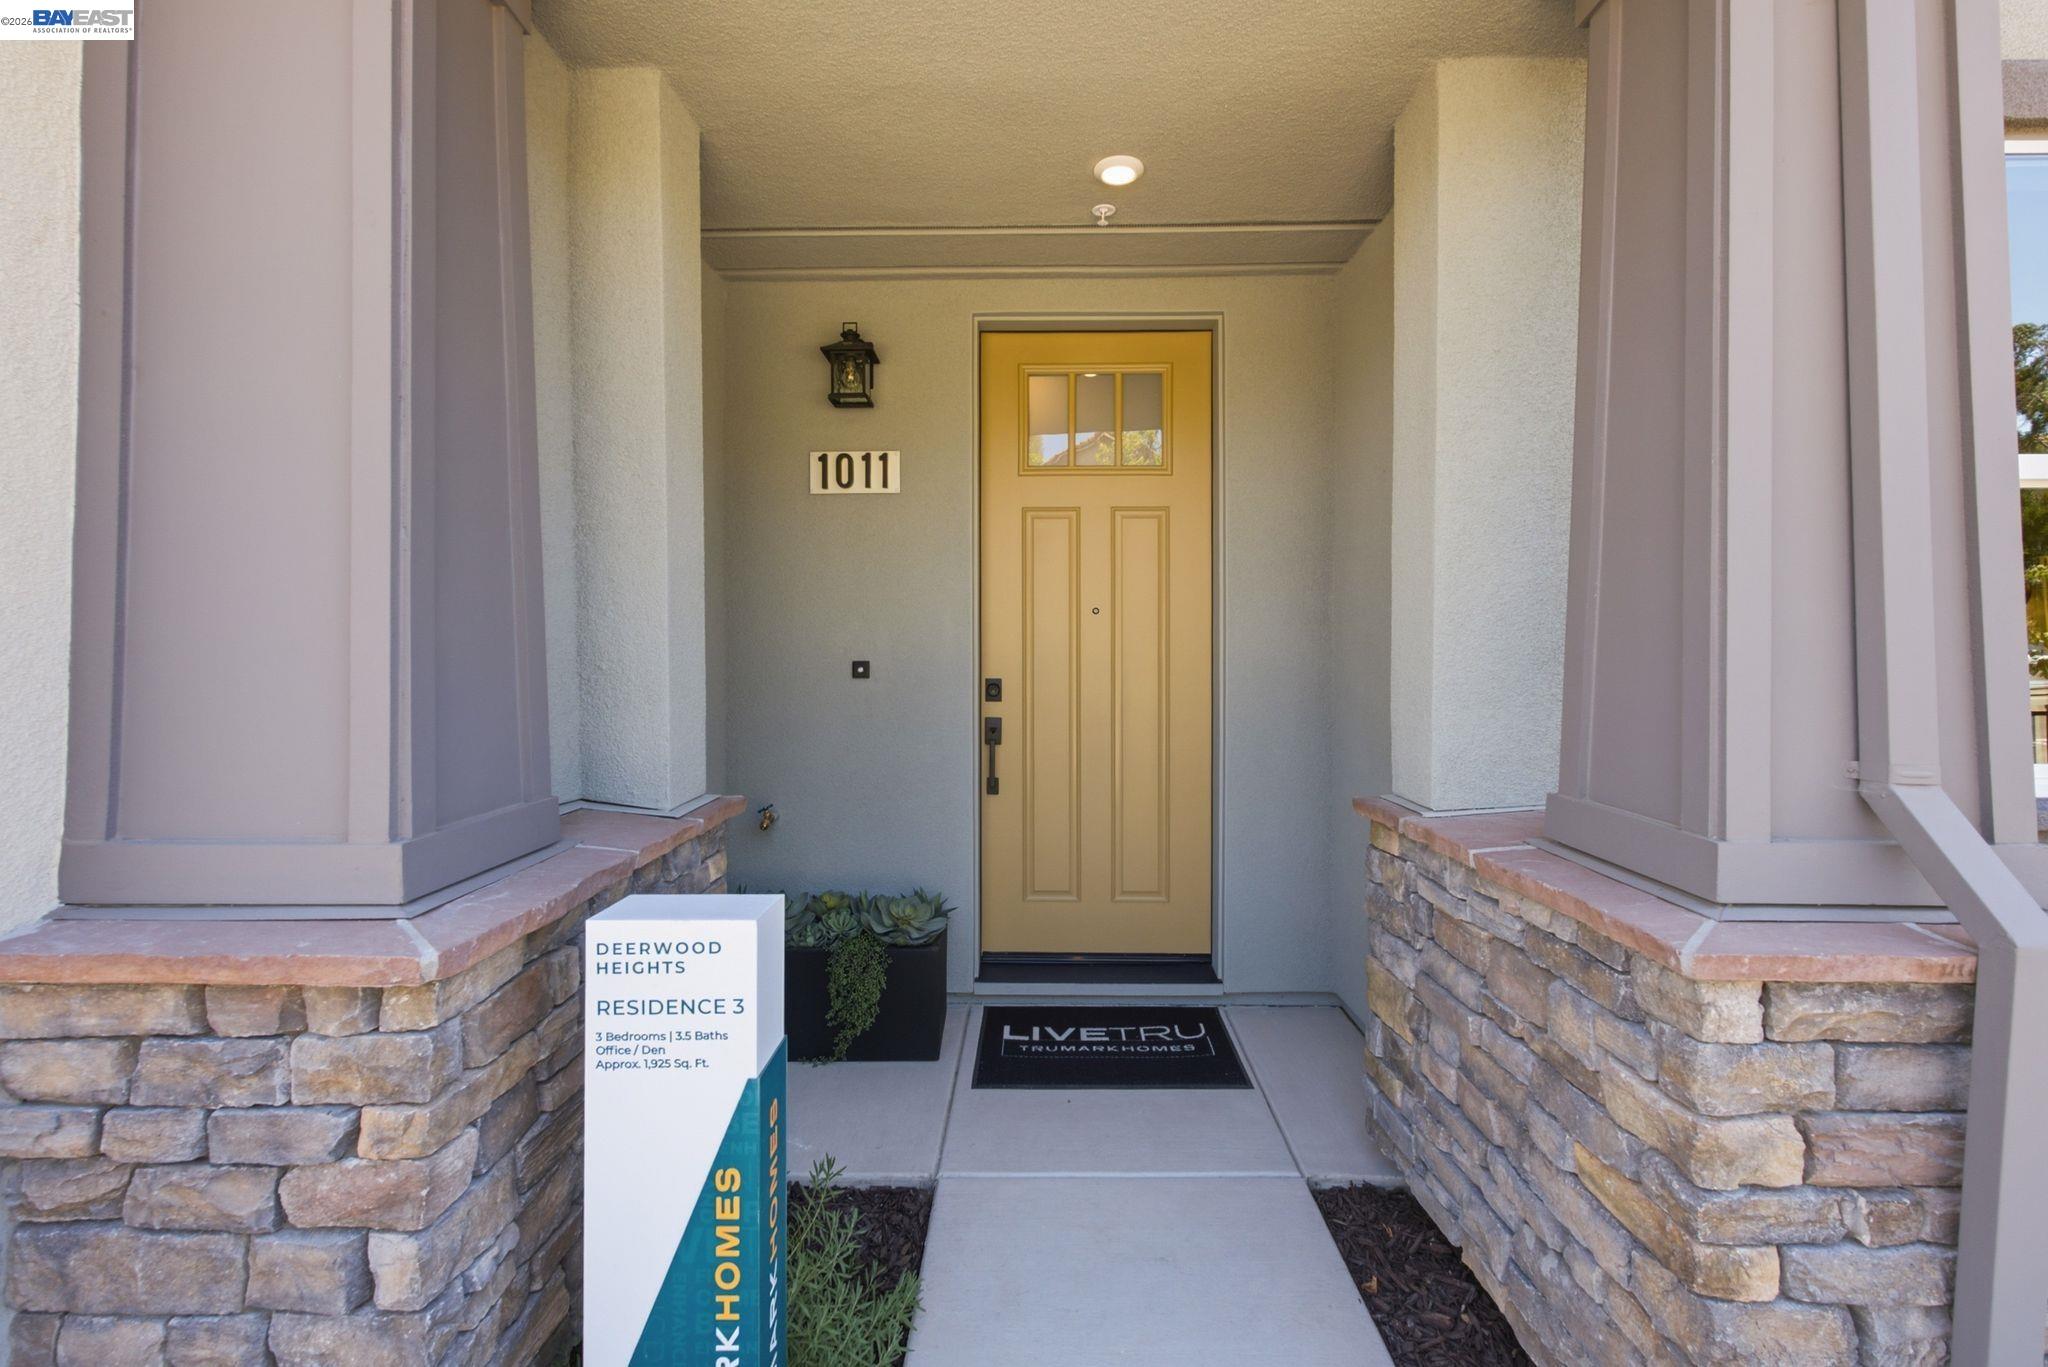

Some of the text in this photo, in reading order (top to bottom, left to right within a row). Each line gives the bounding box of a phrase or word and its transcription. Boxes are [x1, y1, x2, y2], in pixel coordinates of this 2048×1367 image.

[818, 452, 889, 490] 1011
[596, 941, 722, 956] DEERWOOD
[596, 961, 686, 975] HEIGHTS
[597, 998, 745, 1016] RESIDENCE 3
[595, 1032, 603, 1042] 3
[606, 1031, 667, 1042] Bedrooms
[675, 1031, 692, 1041] 3.5
[695, 1031, 729, 1041] Baths
[1003, 1023, 1206, 1042] LIVETRU
[595, 1045, 632, 1056] Office
[642, 1045, 666, 1055] Den
[595, 1058, 710, 1071] Approx. 1,925 Sq. Ft.
